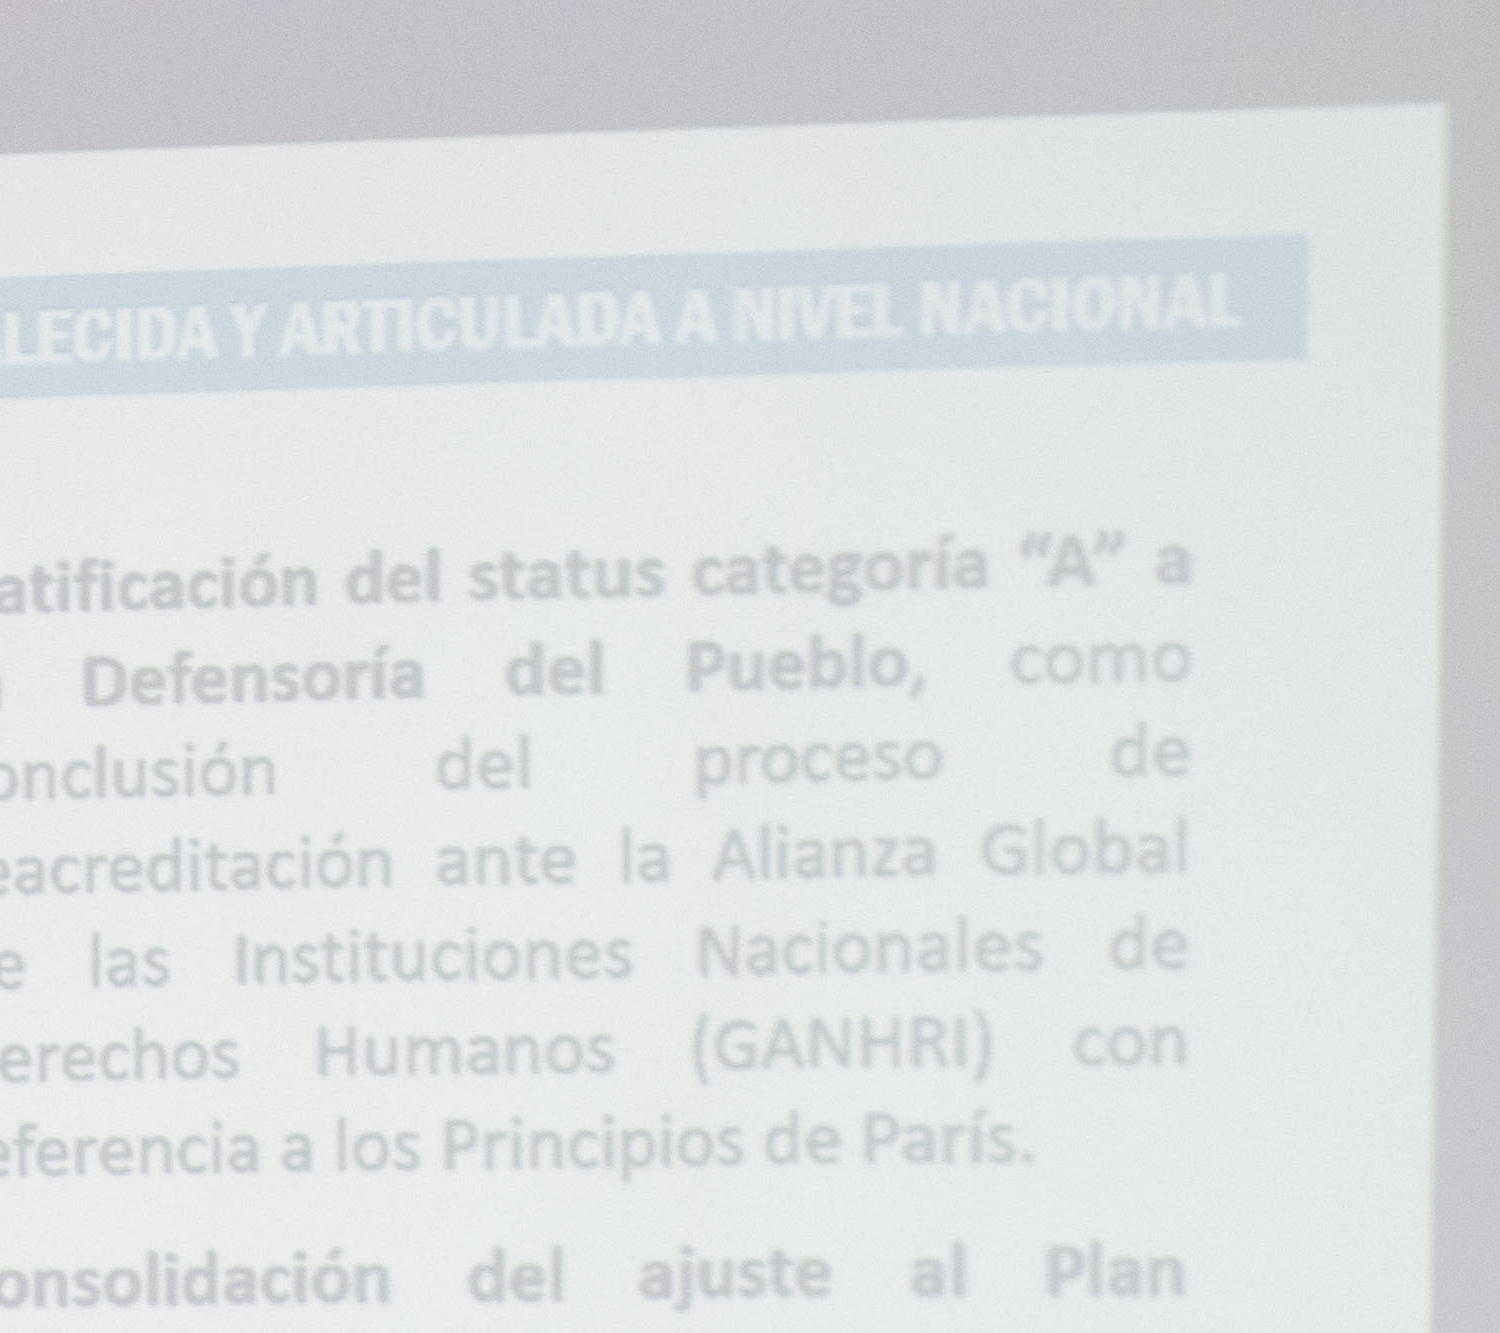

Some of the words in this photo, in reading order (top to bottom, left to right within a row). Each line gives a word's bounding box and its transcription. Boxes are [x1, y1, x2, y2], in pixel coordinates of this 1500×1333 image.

[231, 305, 265, 355] Y
[280, 292, 660, 354] ARTICULADA
[677, 291, 716, 341] A
[735, 285, 900, 339] NIVEL
[923, 273, 1240, 332] NACIONAL
[344, 546, 441, 605] del
[469, 549, 666, 601] status
[691, 534, 988, 605] categoría
[1020, 530, 1125, 586] “A”
[1155, 543, 1192, 585] a
[82, 644, 425, 708] Defensoría
[504, 639, 604, 697] del
[686, 636, 925, 696] Pueblo,
[1010, 642, 1191, 685] como
[435, 733, 531, 792] del
[694, 739, 944, 799] proceso
[1110, 721, 1191, 778] de
[436, 836, 577, 887] ante
[621, 827, 670, 884] la
[712, 825, 936, 880] Alianza
[980, 818, 1188, 876] Global
[89, 933, 171, 989] las
[234, 928, 634, 985] Instituciones
[697, 918, 1044, 976] Nacionales
[1109, 914, 1189, 972] de
[316, 1025, 615, 1077] Humanos
[690, 1011, 993, 1083] (GANHRI)
[1072, 1024, 1188, 1068] con
[280, 1131, 315, 1174] a
[335, 1117, 422, 1173] los
[442, 1115, 745, 1182] Principios
[764, 1112, 842, 1166] de
[863, 1109, 1032, 1165] París.
[467, 1246, 564, 1303] del
[639, 1245, 832, 1310] ajuste
[911, 1241, 967, 1297] al
[1046, 1240, 1185, 1297] Plan
